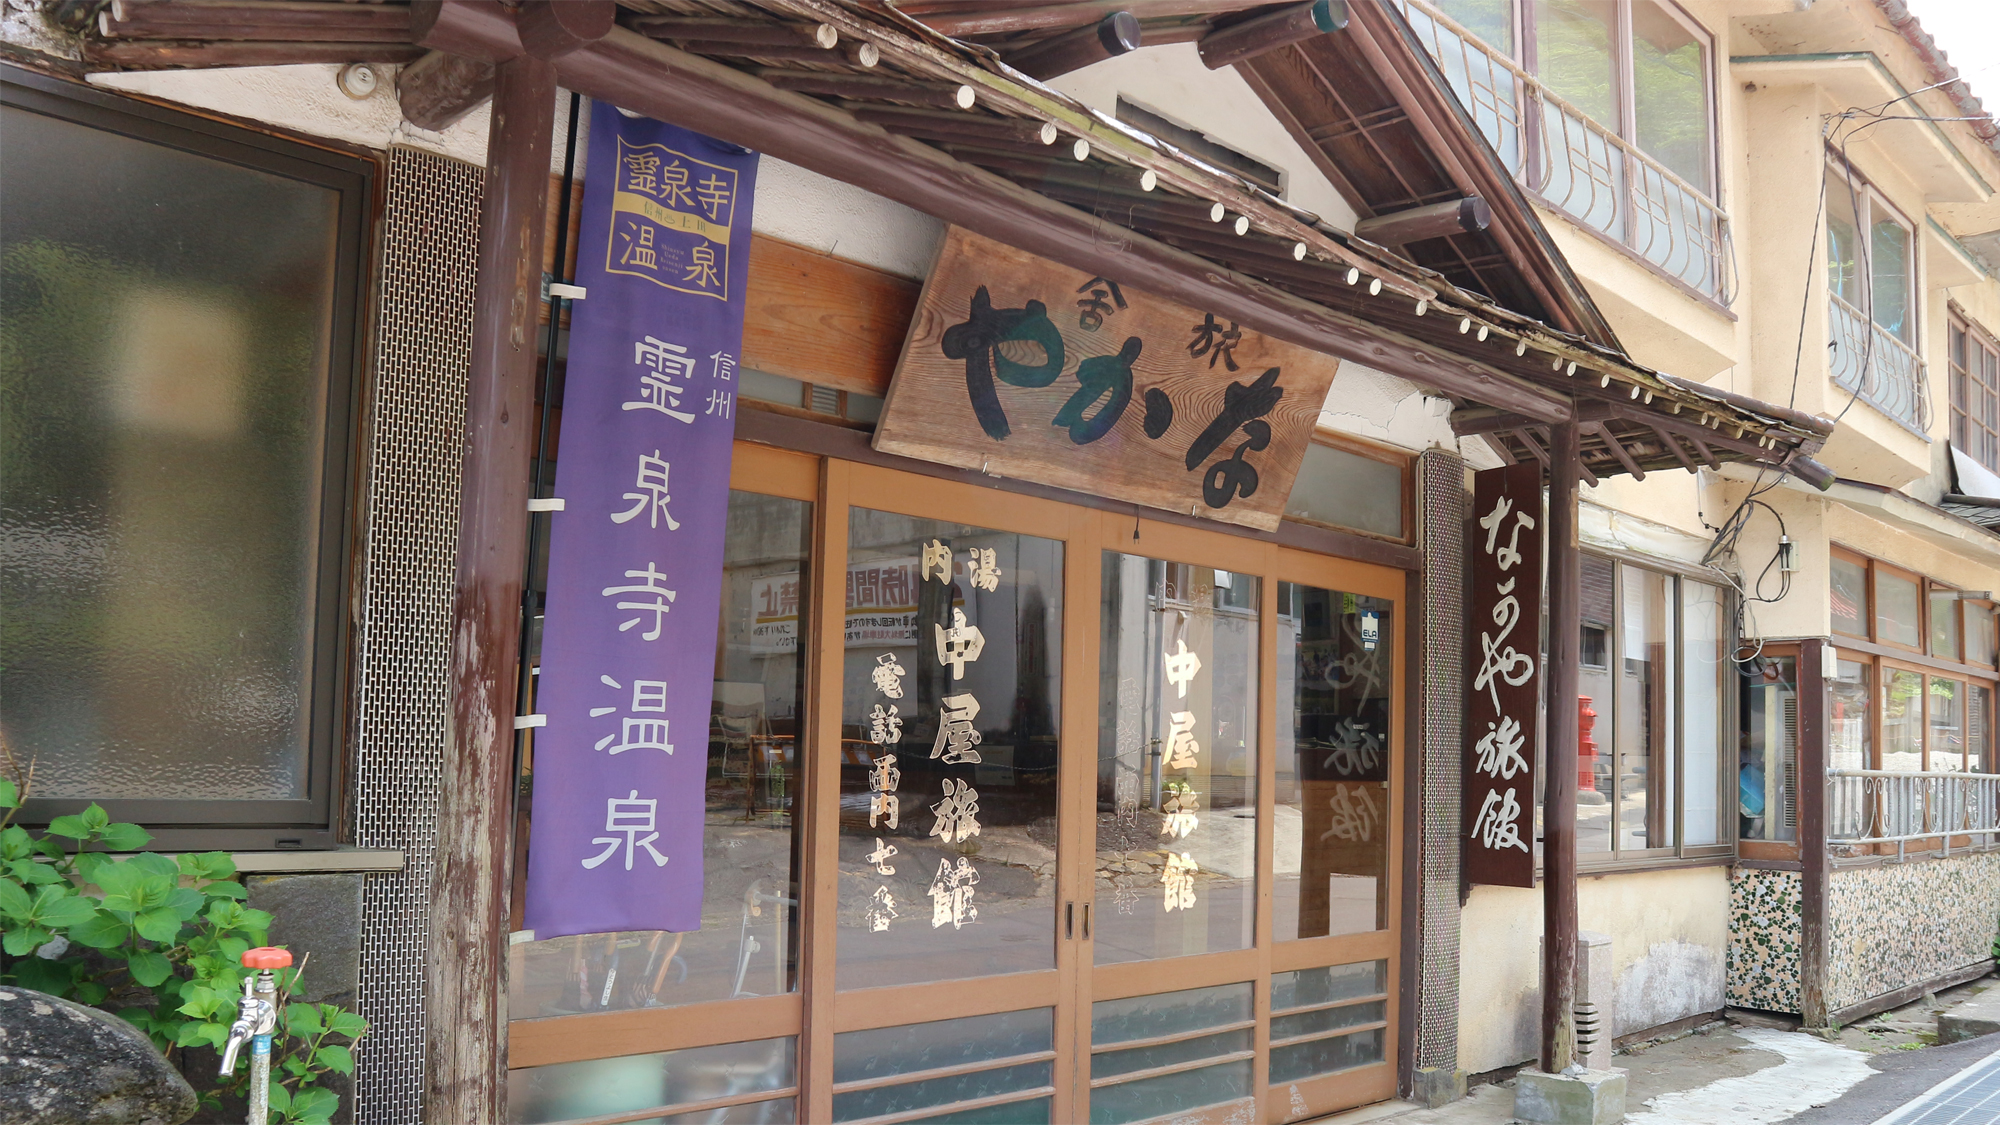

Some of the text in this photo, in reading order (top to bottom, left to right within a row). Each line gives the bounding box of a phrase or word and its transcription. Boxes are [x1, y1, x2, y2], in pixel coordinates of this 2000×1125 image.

[622, 151, 732, 221] 霊泉寺
[644, 200, 663, 222] 信州
[619, 220, 722, 288] 温泉
[704, 350, 737, 420] 信州
[581, 335, 696, 871] 霊泉寺温泉
[929, 606, 987, 931] 中屋旅館
